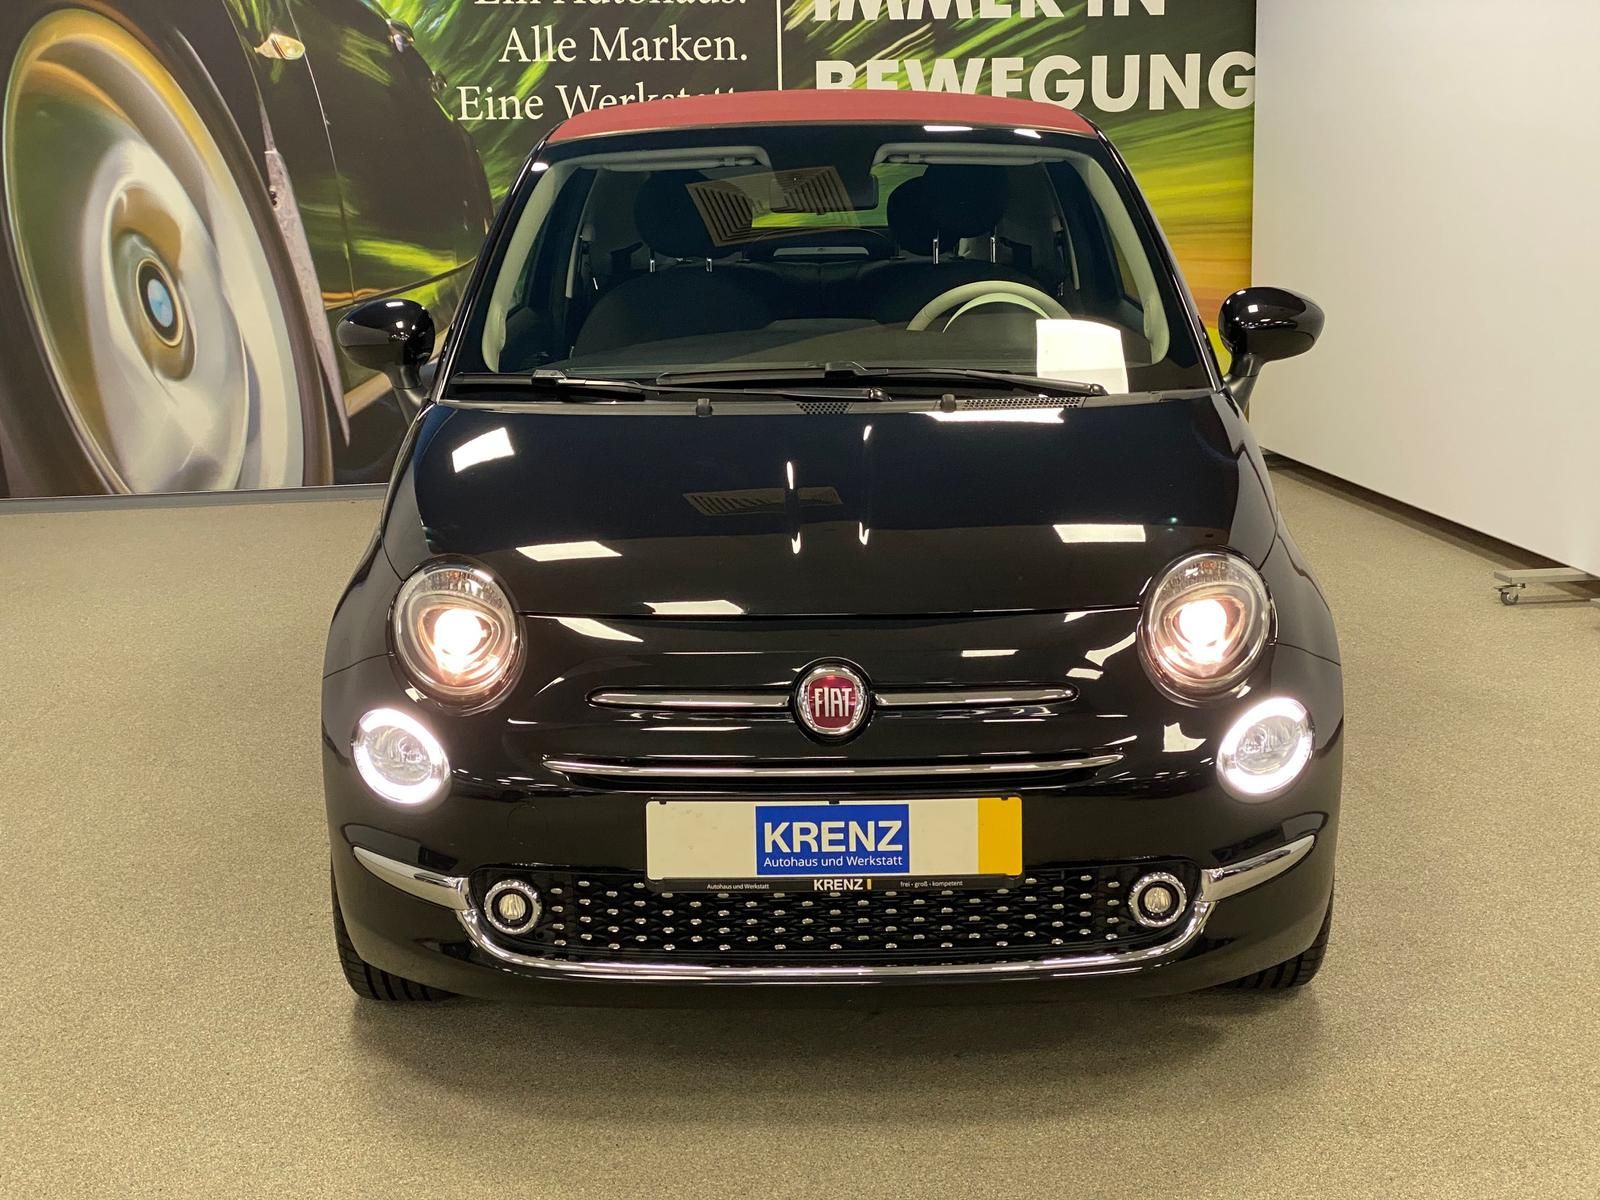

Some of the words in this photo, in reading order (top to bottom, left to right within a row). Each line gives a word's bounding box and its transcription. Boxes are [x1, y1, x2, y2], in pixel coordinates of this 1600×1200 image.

[499, 26, 577, 63] Alle
[590, 25, 748, 61] Marken.
[456, 86, 544, 121] Eine
[814, 687, 852, 718] FIAT
[764, 820, 903, 853] KRENZ
[763, 857, 818, 867] Autohaus
[821, 856, 843, 866] und
[846, 855, 903, 866] Werkstatt
[813, 879, 864, 891] KRENZ
